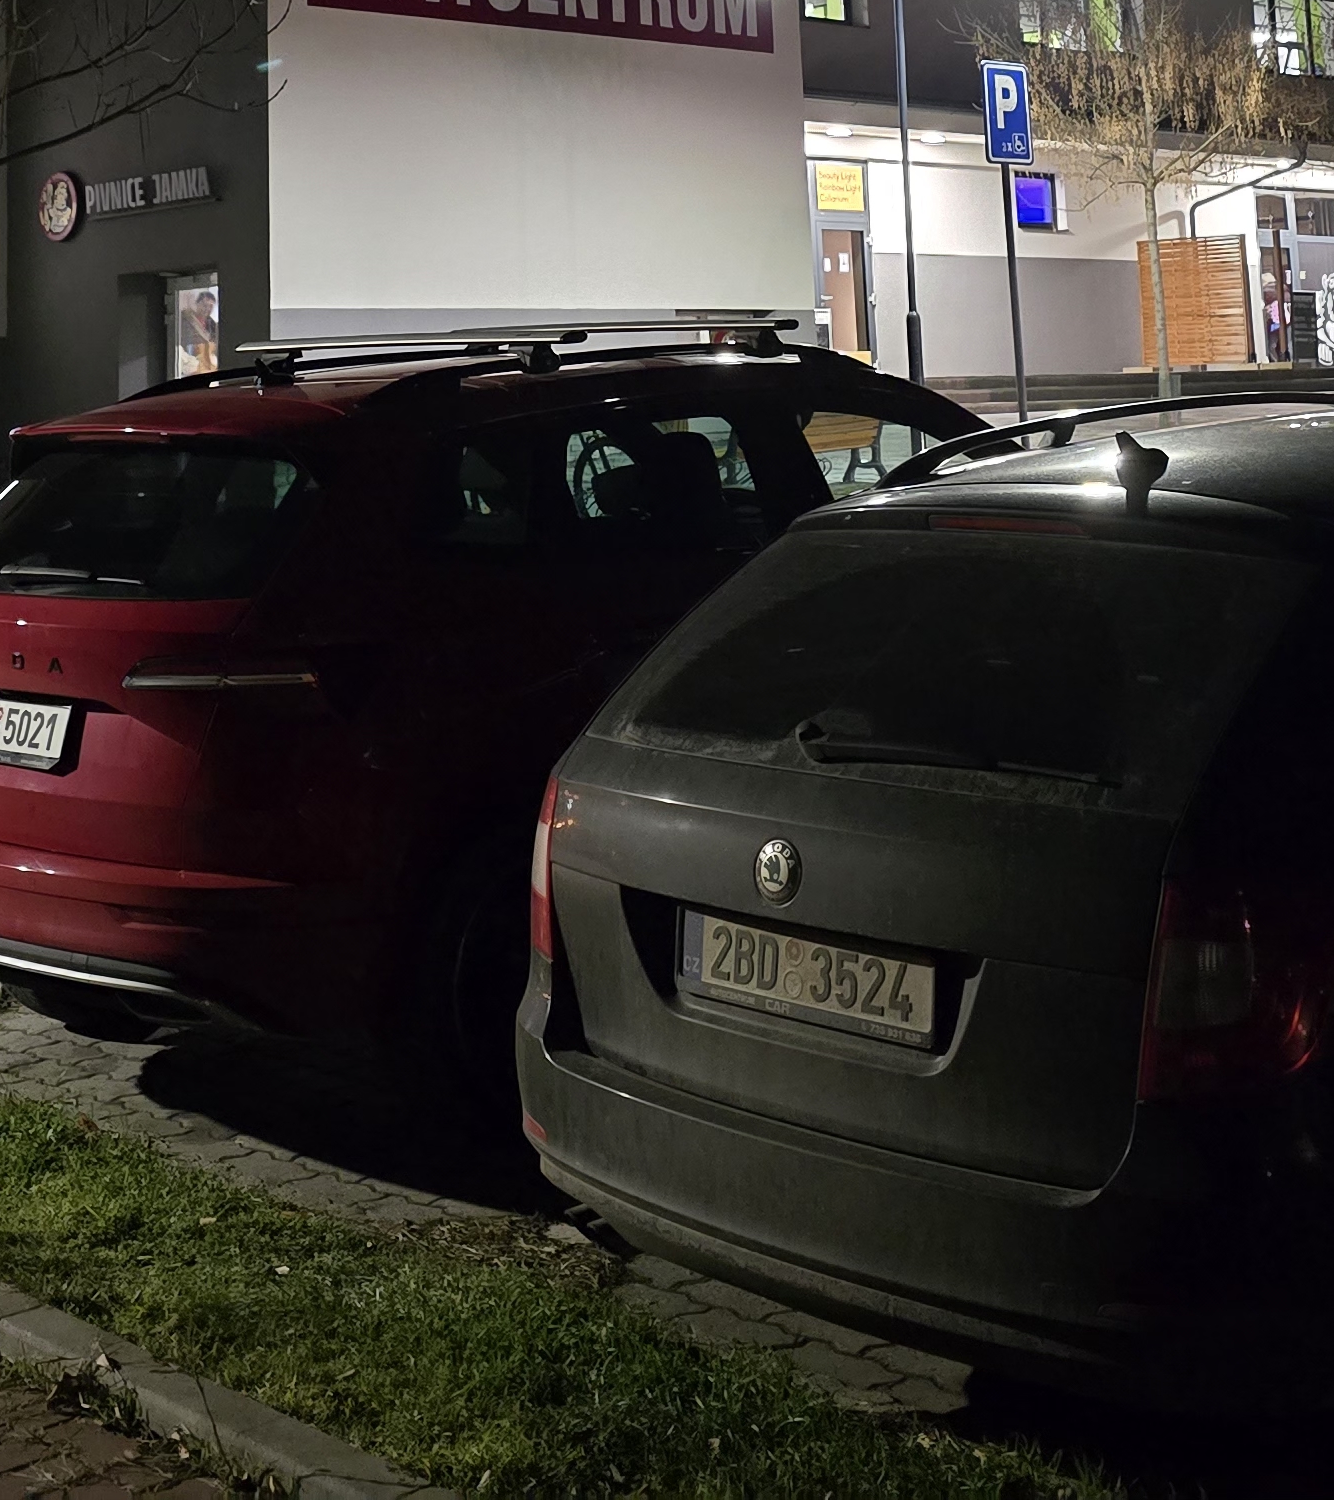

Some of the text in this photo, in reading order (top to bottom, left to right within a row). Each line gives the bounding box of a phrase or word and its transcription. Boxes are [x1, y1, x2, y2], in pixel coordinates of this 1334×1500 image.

[994, 74, 1018, 129] P
[84, 166, 210, 215] PIVNICE JAMKA
[3, 707, 59, 751] 5021
[683, 955, 700, 974] CZ
[710, 924, 914, 1023] 2BD 3524
[765, 999, 791, 1016] CAR
